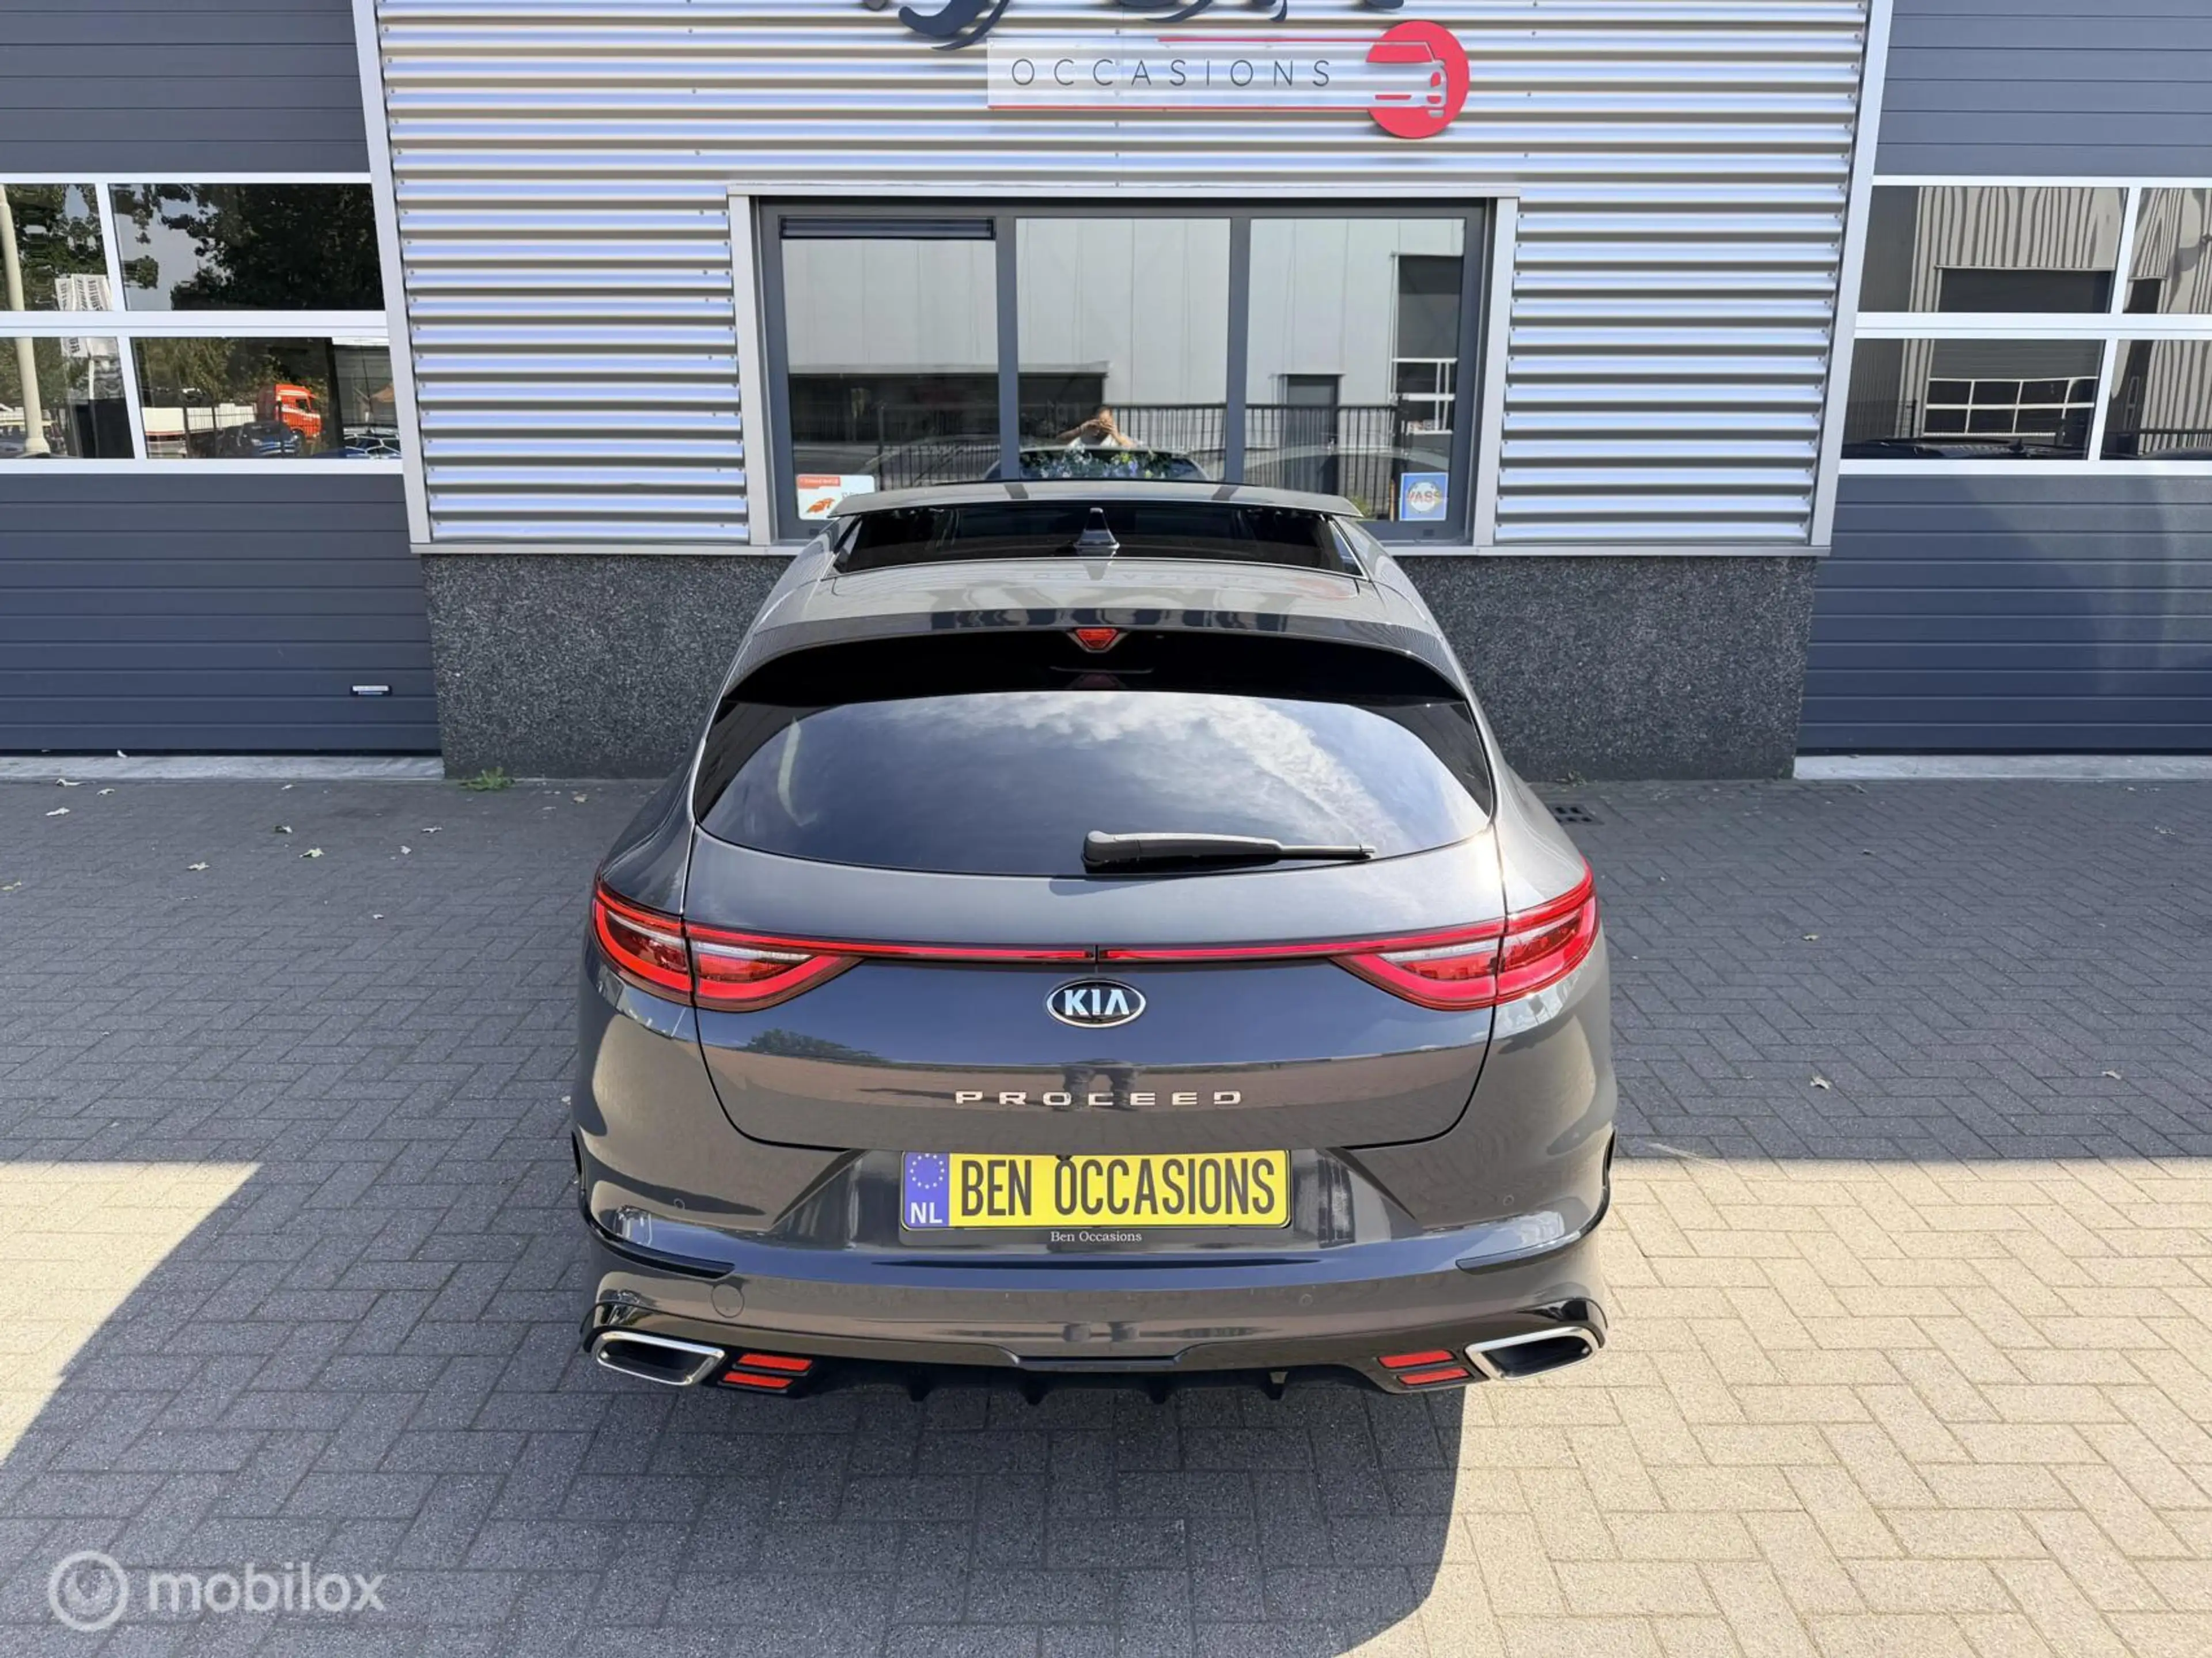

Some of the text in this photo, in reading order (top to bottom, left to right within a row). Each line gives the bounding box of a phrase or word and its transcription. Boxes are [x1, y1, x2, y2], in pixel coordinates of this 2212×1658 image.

[1011, 58, 1331, 87] OCCASIONS
[1063, 988, 1130, 1016] KIA
[955, 1090, 1242, 1107] PROCEED
[961, 1158, 1275, 1217] BEN OCCASIONS
[910, 1201, 943, 1224] NL
[1050, 1230, 1143, 1242] Ben Occasions
